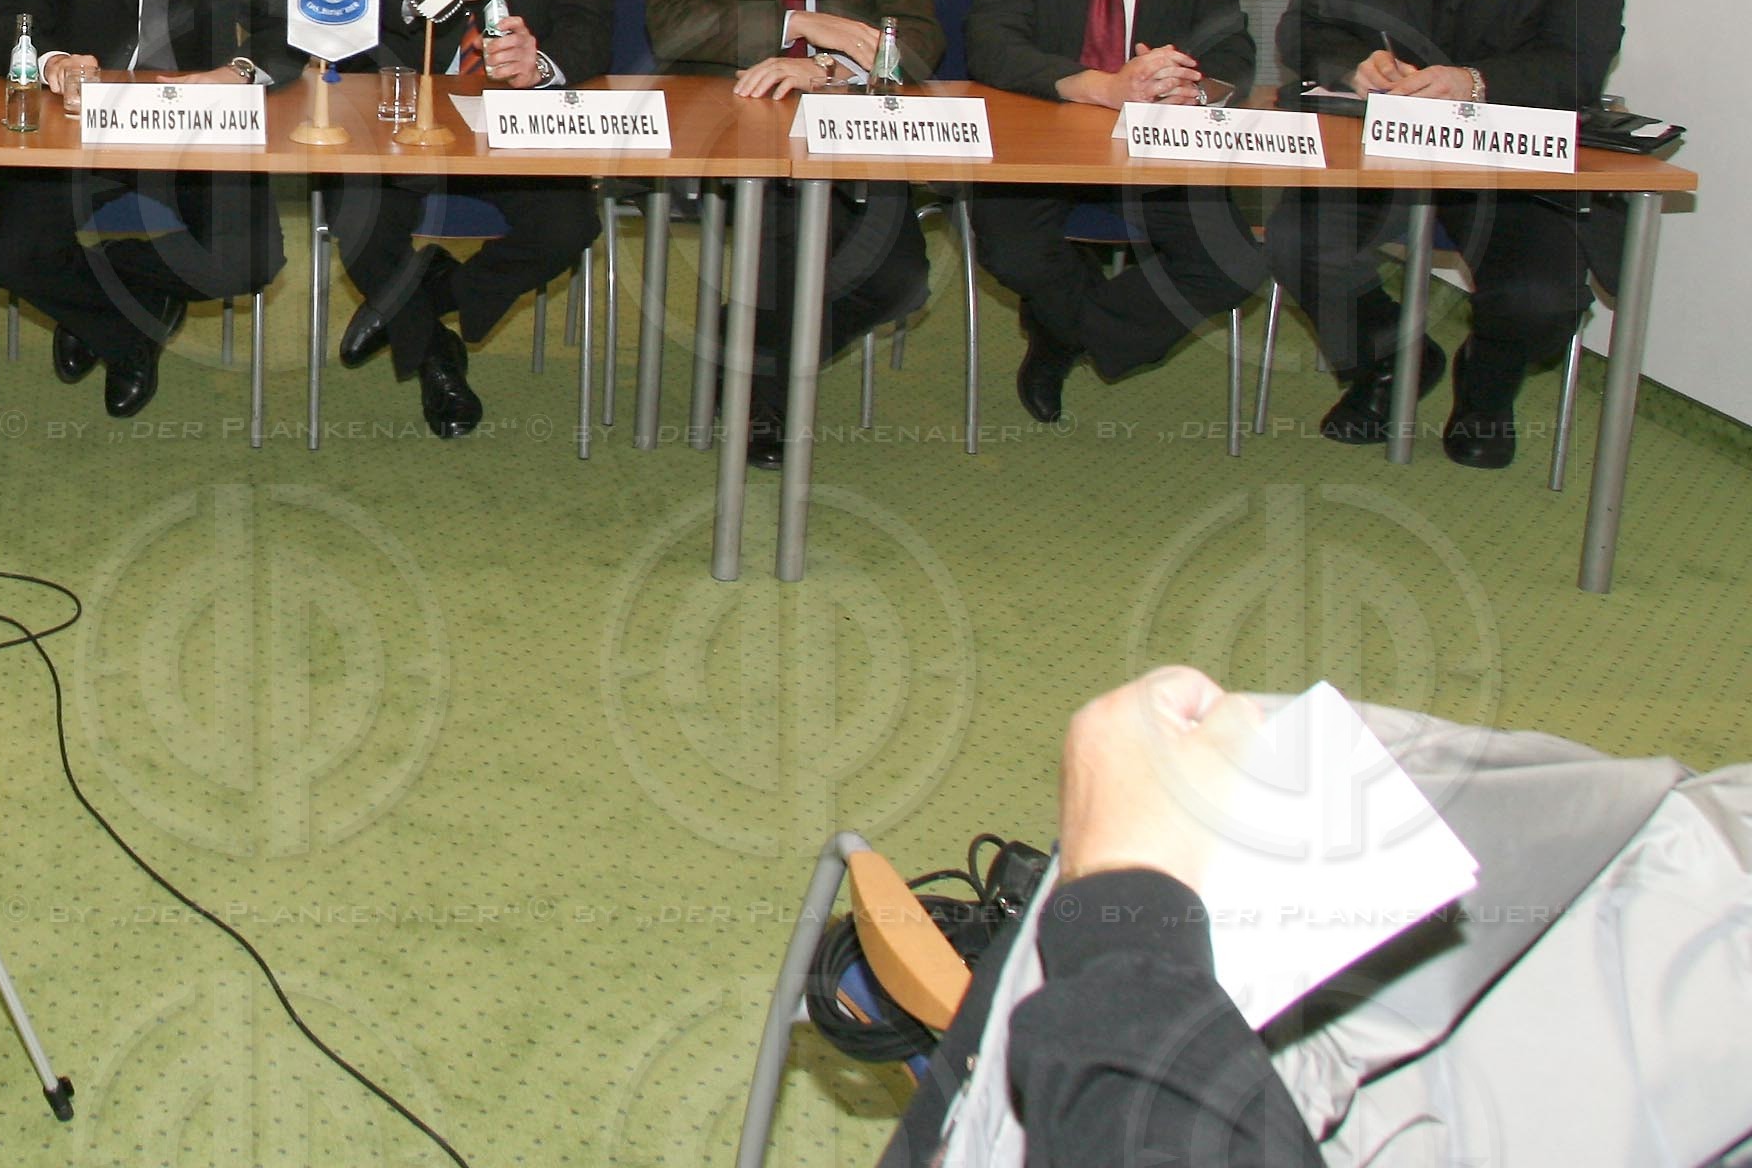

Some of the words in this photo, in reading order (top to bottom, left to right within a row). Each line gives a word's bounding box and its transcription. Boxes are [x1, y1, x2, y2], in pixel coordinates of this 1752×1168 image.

[86, 108, 124, 129] MBA.
[130, 109, 213, 130] CHRISTIAN
[220, 110, 260, 130] JAUK
[499, 115, 524, 134] DR.
[529, 114, 595, 135] MICHAEL
[600, 115, 658, 135] DREXEL
[818, 119, 842, 140] DR.
[846, 120, 898, 141] STEFAN
[903, 121, 980, 143] FATTINGER
[1132, 126, 1189, 147] GERALD
[1196, 130, 1317, 155] STOCKENHUBER
[1371, 119, 1464, 149] GERHARD
[1472, 129, 1567, 159] MARBLER
